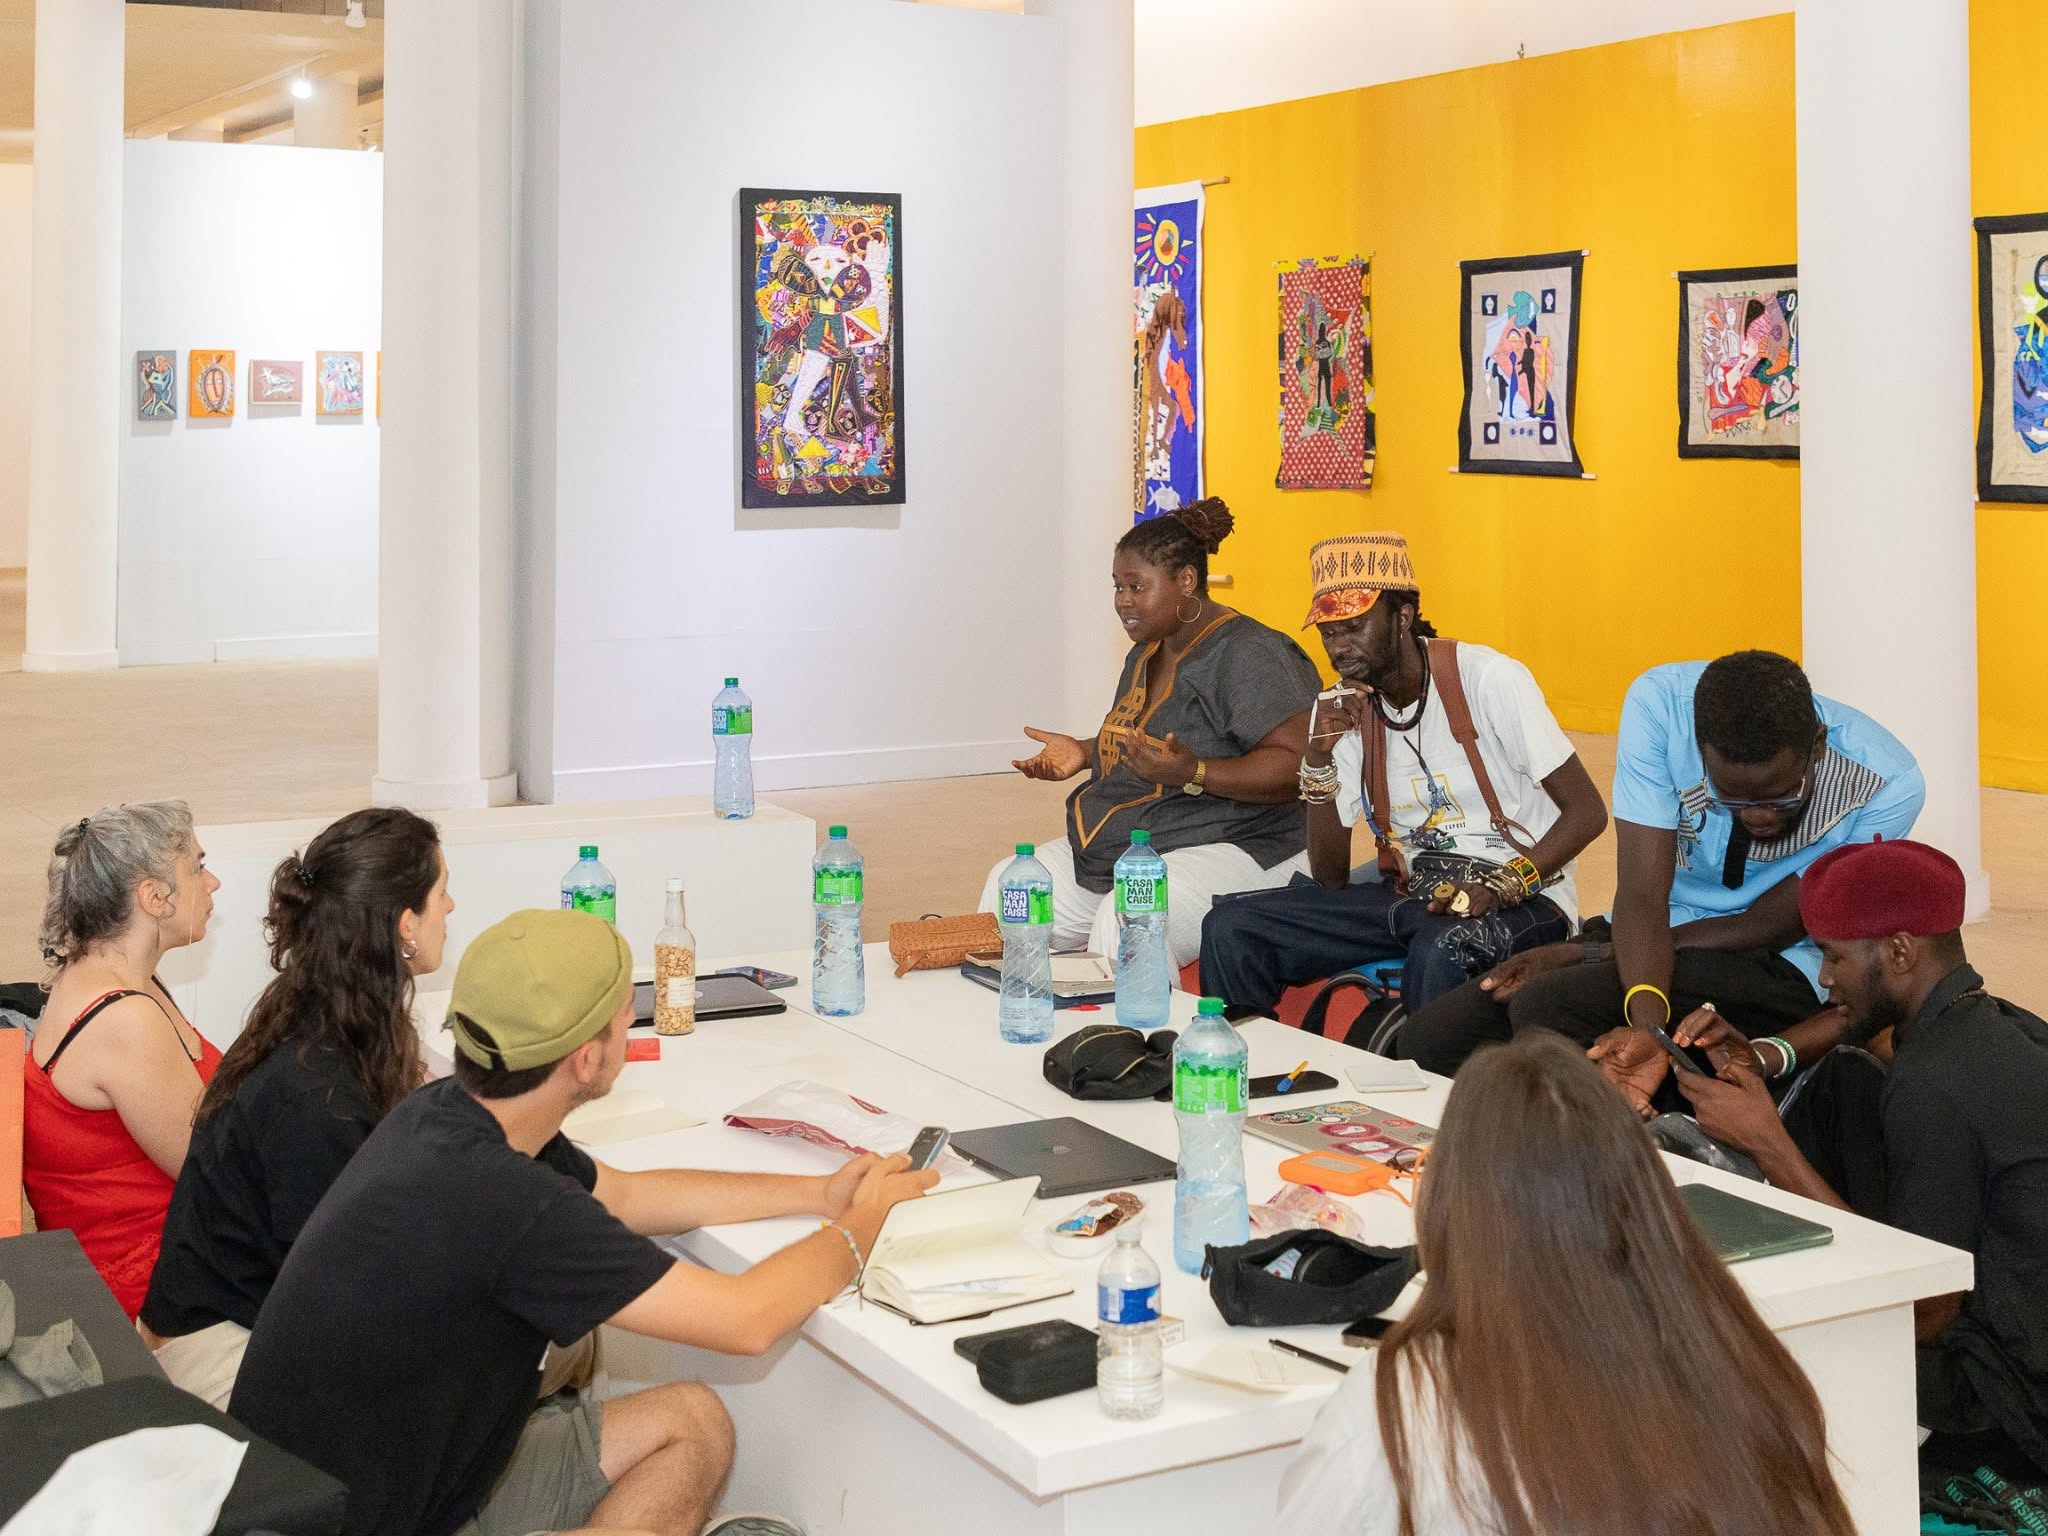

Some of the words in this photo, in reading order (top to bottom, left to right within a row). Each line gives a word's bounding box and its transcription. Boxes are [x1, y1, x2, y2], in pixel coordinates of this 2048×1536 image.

[1126, 879, 1153, 887] CASA
[1003, 890, 1027, 901] CASA
[1127, 887, 1153, 896] MAN
[1003, 899, 1027, 908] MAN
[1126, 896, 1154, 904] CAISE
[1003, 907, 1028, 917] CAISE
